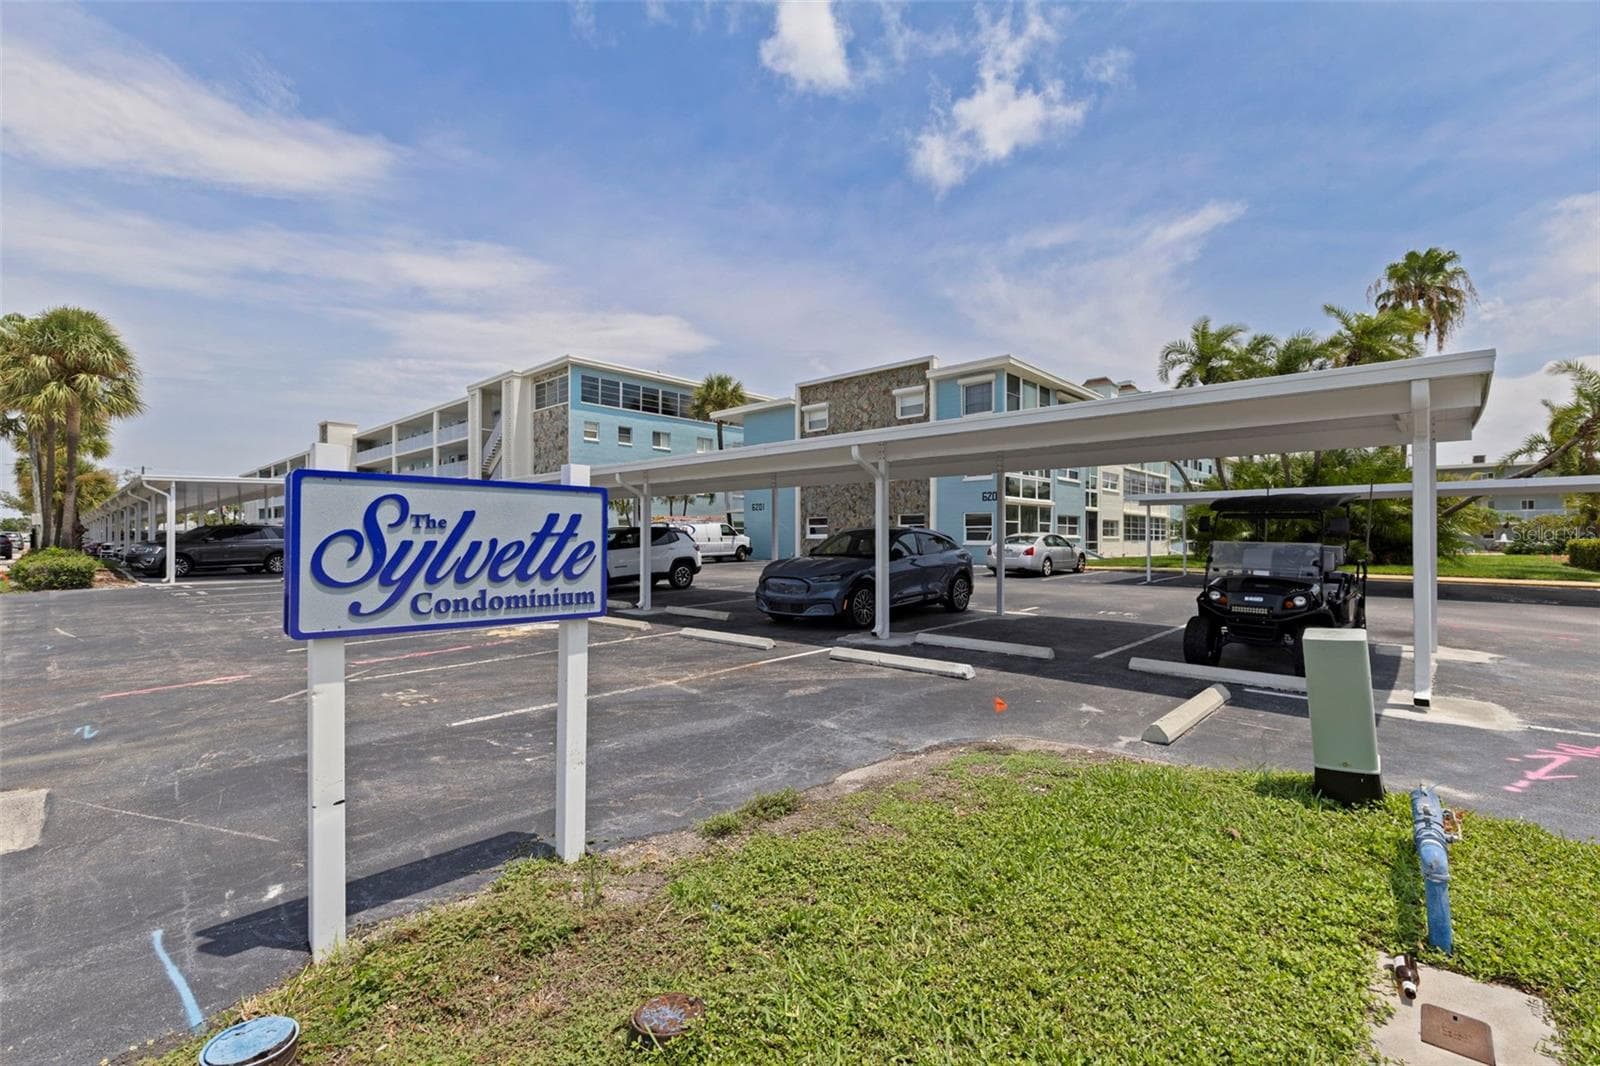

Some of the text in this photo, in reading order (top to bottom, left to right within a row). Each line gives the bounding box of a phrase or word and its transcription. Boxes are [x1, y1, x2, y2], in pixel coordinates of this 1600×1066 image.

[751, 503, 765, 512] 6201
[410, 514, 447, 530] The
[310, 493, 597, 617] Sylvette
[410, 588, 596, 616] Condominium
